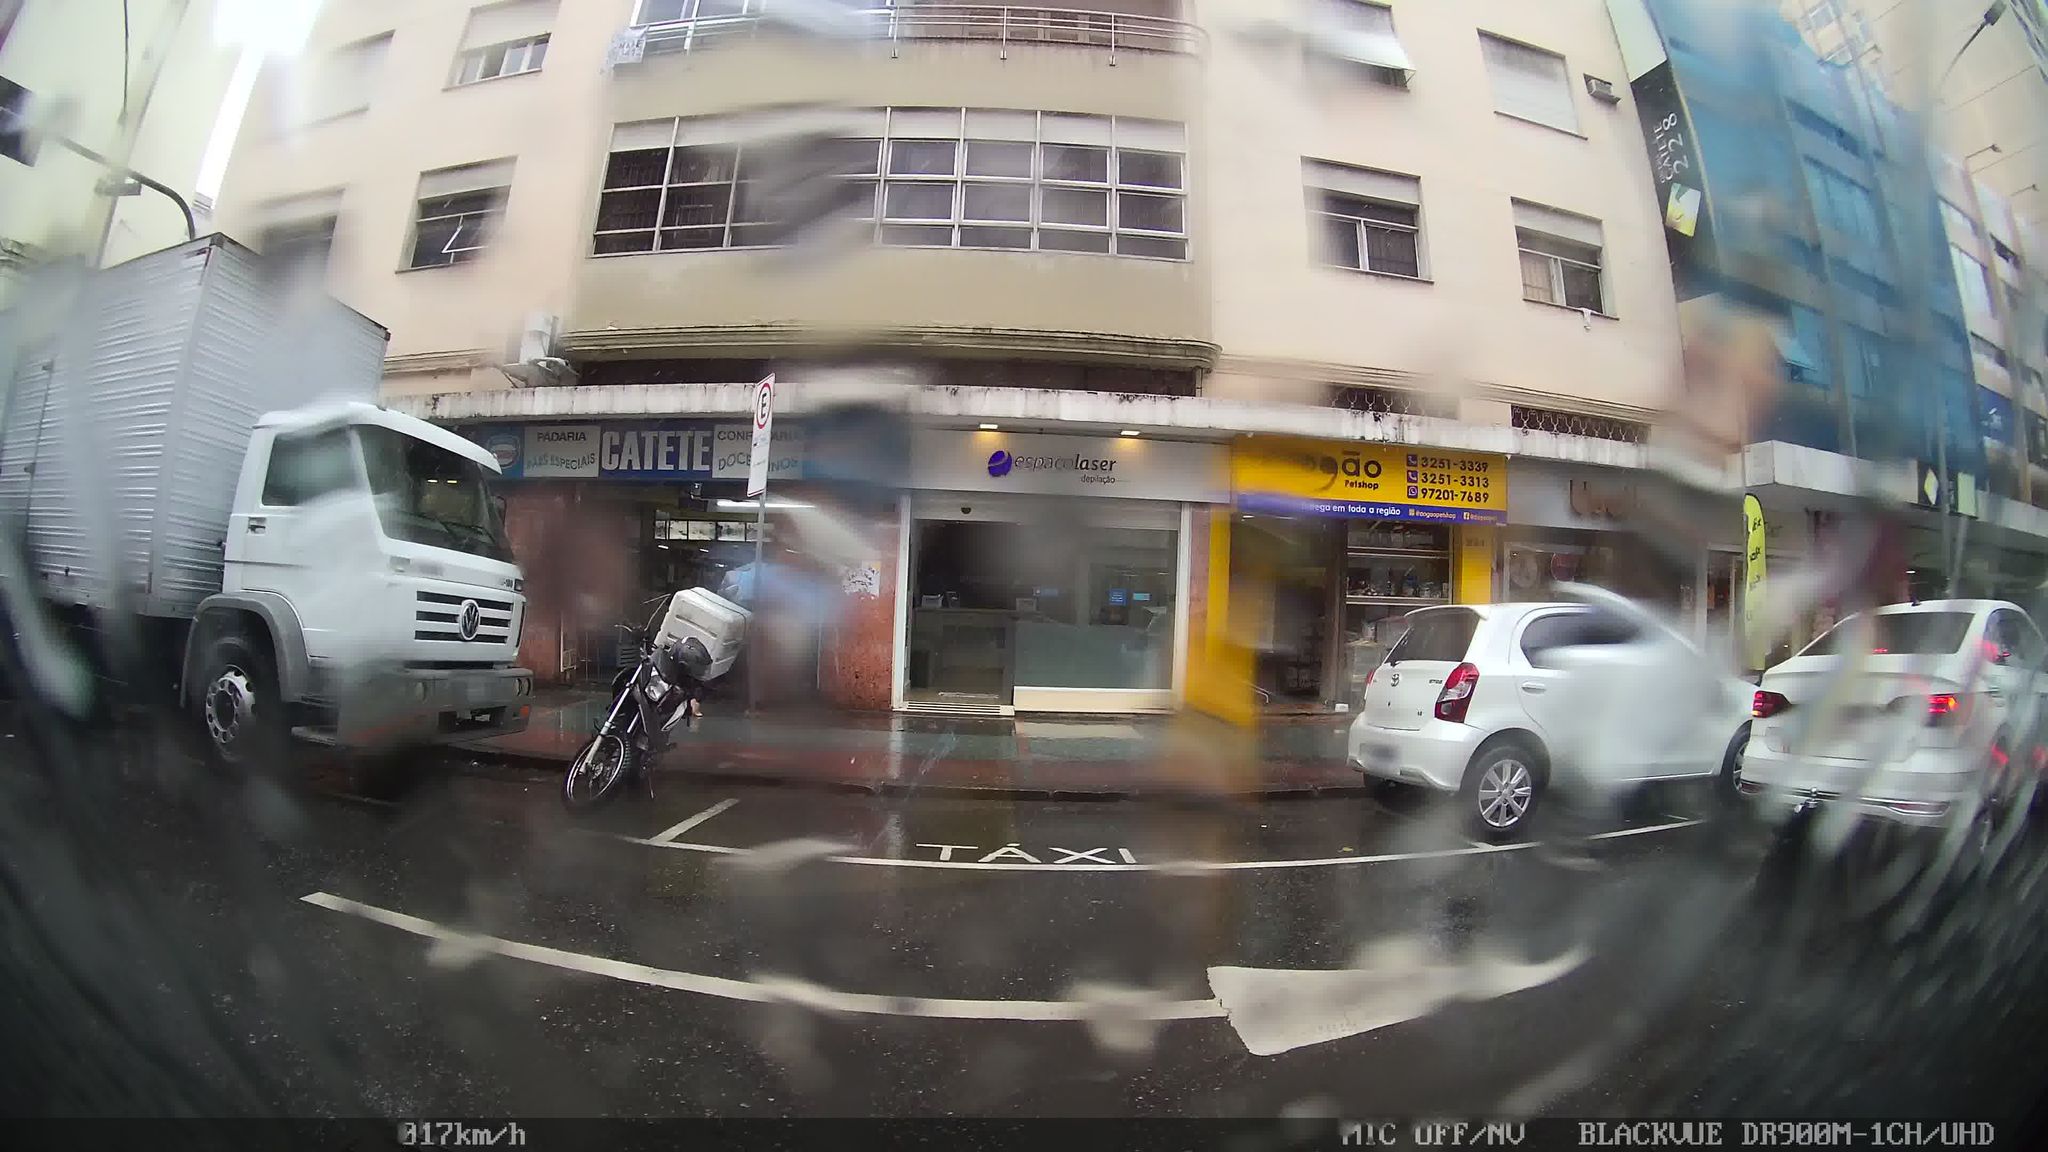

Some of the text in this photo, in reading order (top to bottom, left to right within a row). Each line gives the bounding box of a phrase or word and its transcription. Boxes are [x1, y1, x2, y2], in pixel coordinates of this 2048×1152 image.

[1662, 112, 1689, 174] 228
[761, 392, 767, 418] E
[537, 431, 587, 442] PADARIA
[602, 431, 712, 471] CATETE
[1421, 457, 1489, 472] 3251-3339
[1345, 480, 1379, 490] Petshop
[1421, 473, 1489, 488] 3251-3313
[1421, 488, 1489, 503] 97201-7689
[1348, 505, 1366, 513] toda
[1376, 506, 1401, 517] região
[916, 843, 1137, 864] TÁXI
